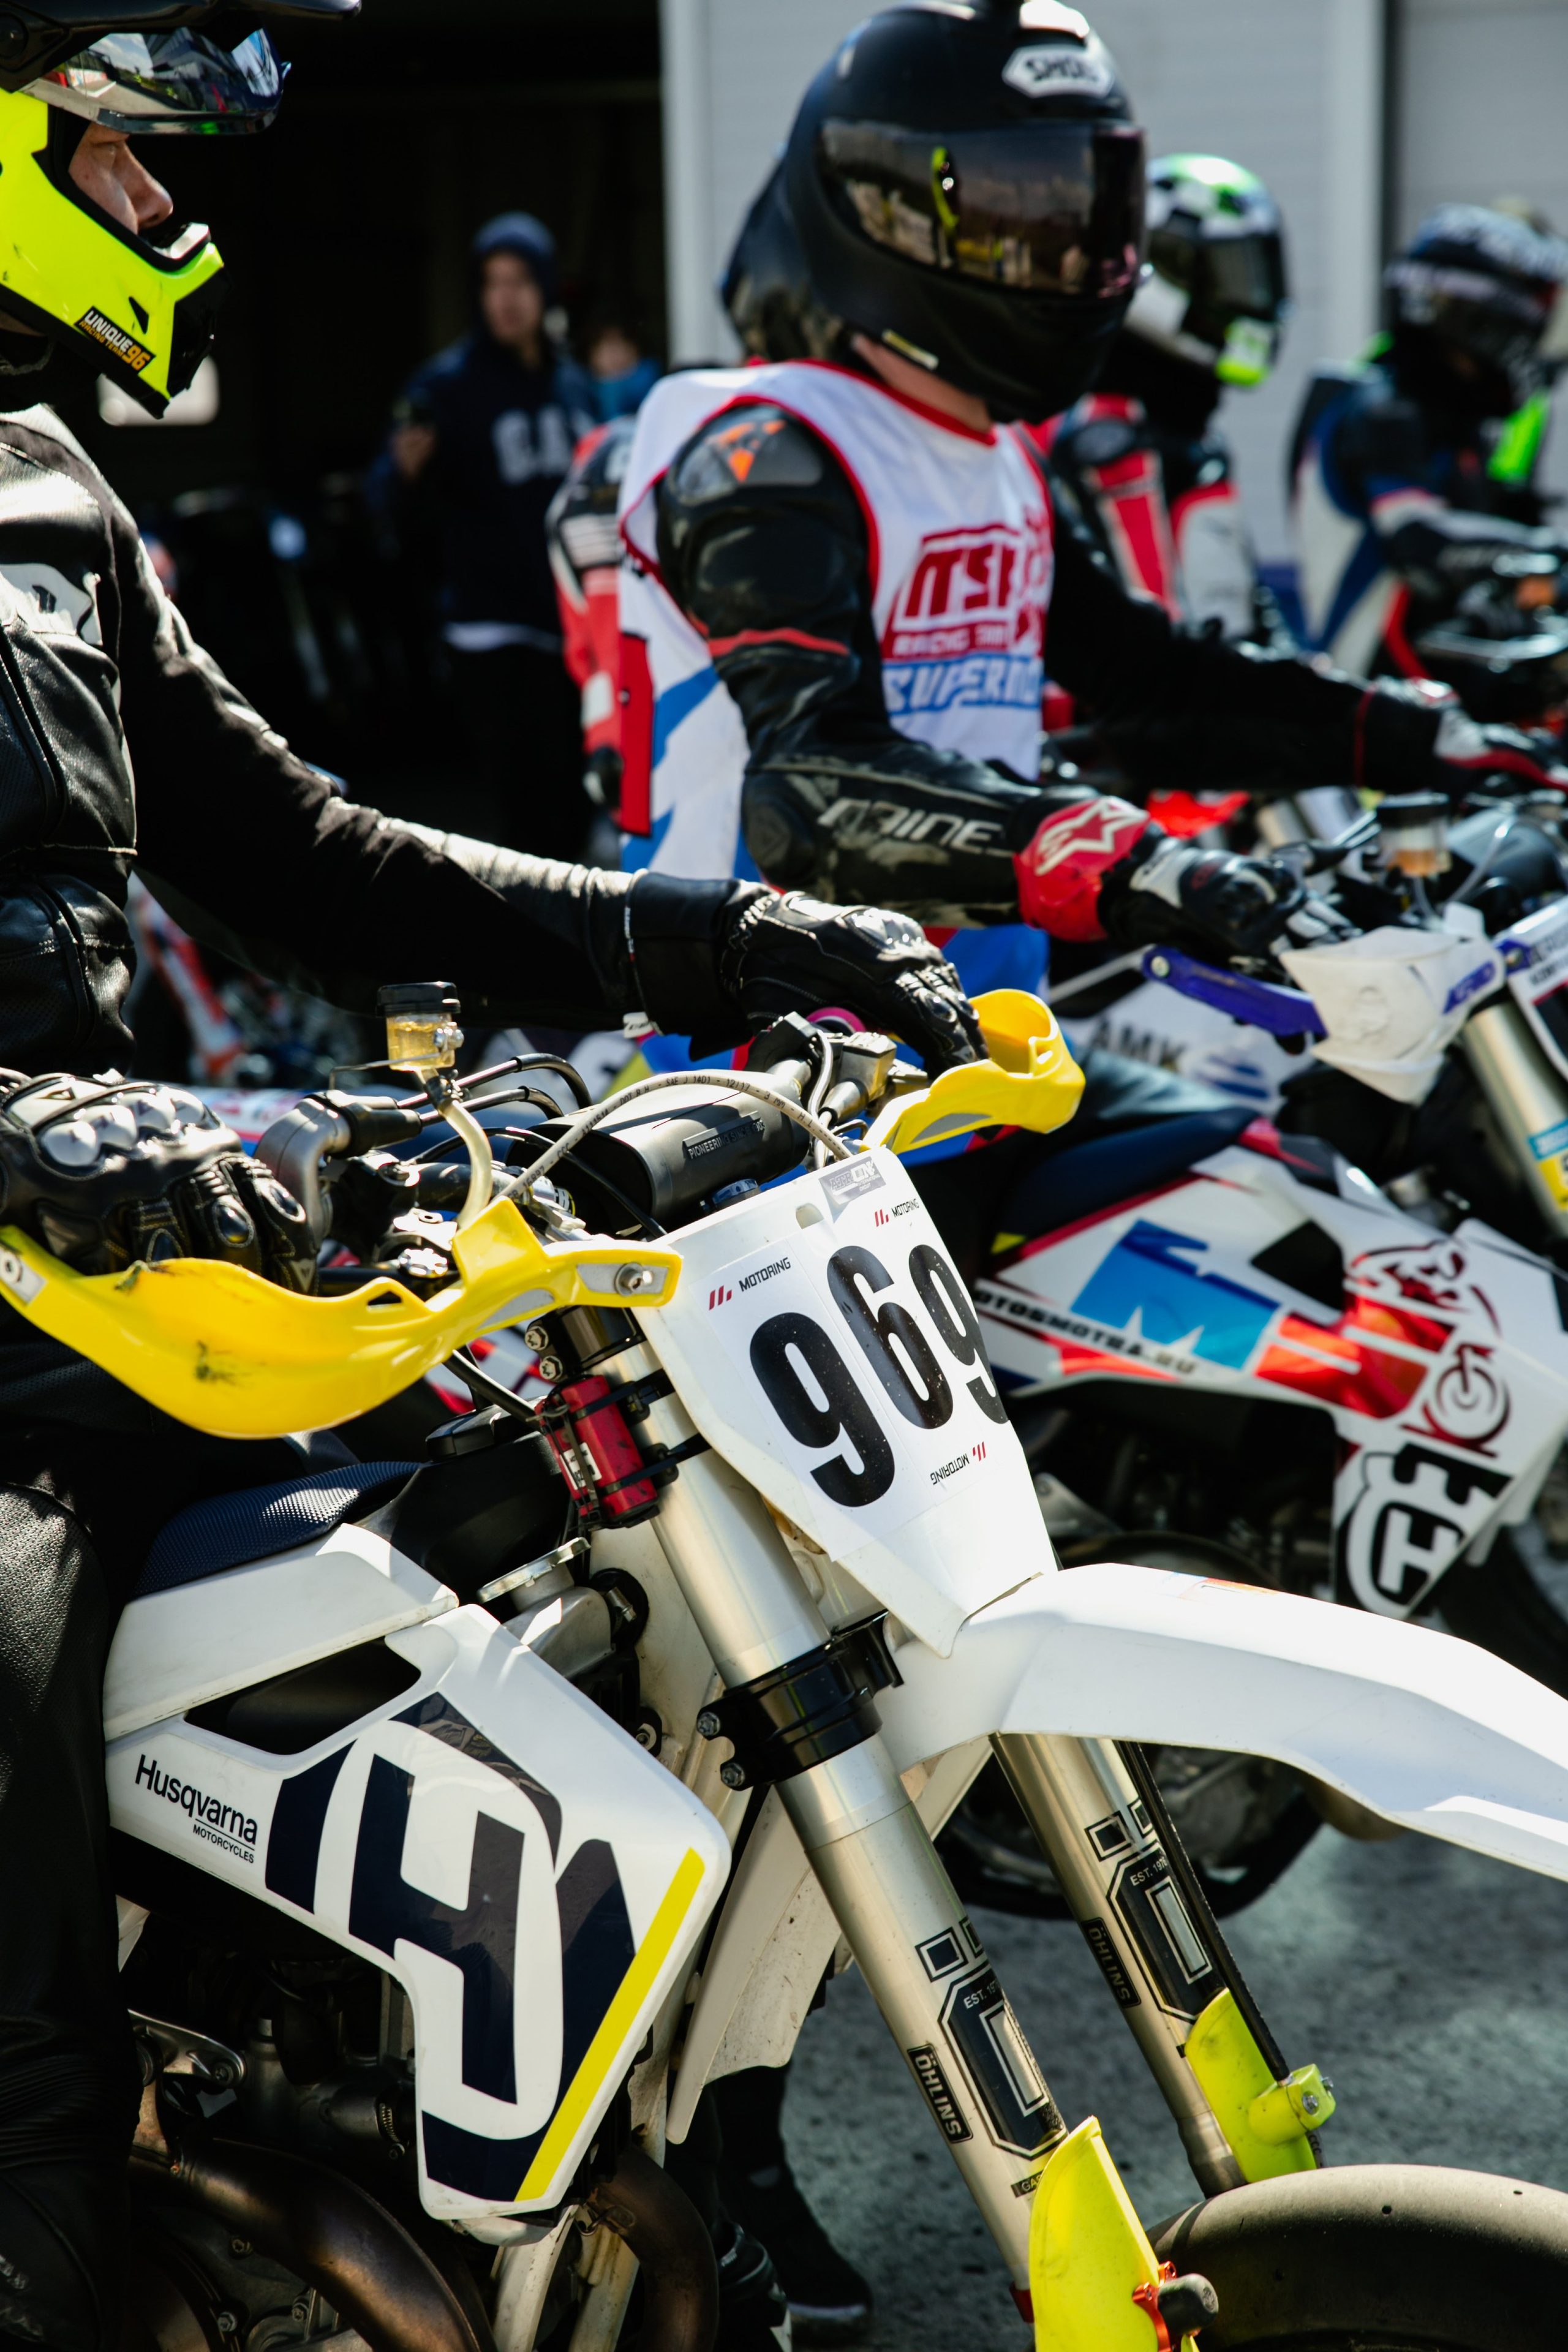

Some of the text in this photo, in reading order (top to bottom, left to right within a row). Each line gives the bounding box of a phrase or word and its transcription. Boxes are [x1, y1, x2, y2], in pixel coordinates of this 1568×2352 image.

[79, 320, 107, 344] RACING
[84, 310, 151, 371] UNIQUE 96
[666, 1077, 679, 1087] SAE
[688, 1134, 729, 1159] PIONEERING
[891, 1198, 920, 1218] MOTORING
[739, 1257, 791, 1292] MOTORING
[750, 1244, 1009, 1508] 969
[930, 1453, 970, 1485] MOTORING
[135, 1754, 258, 1845] Husqvarna
[193, 1823, 254, 1864] MOTORCYCLES
[1129, 1868, 1153, 1887] EST.
[1088, 1926, 1131, 2000] ÖHLINS
[963, 1989, 986, 2010] EST.
[914, 2052, 962, 2135] ÖHLINS
